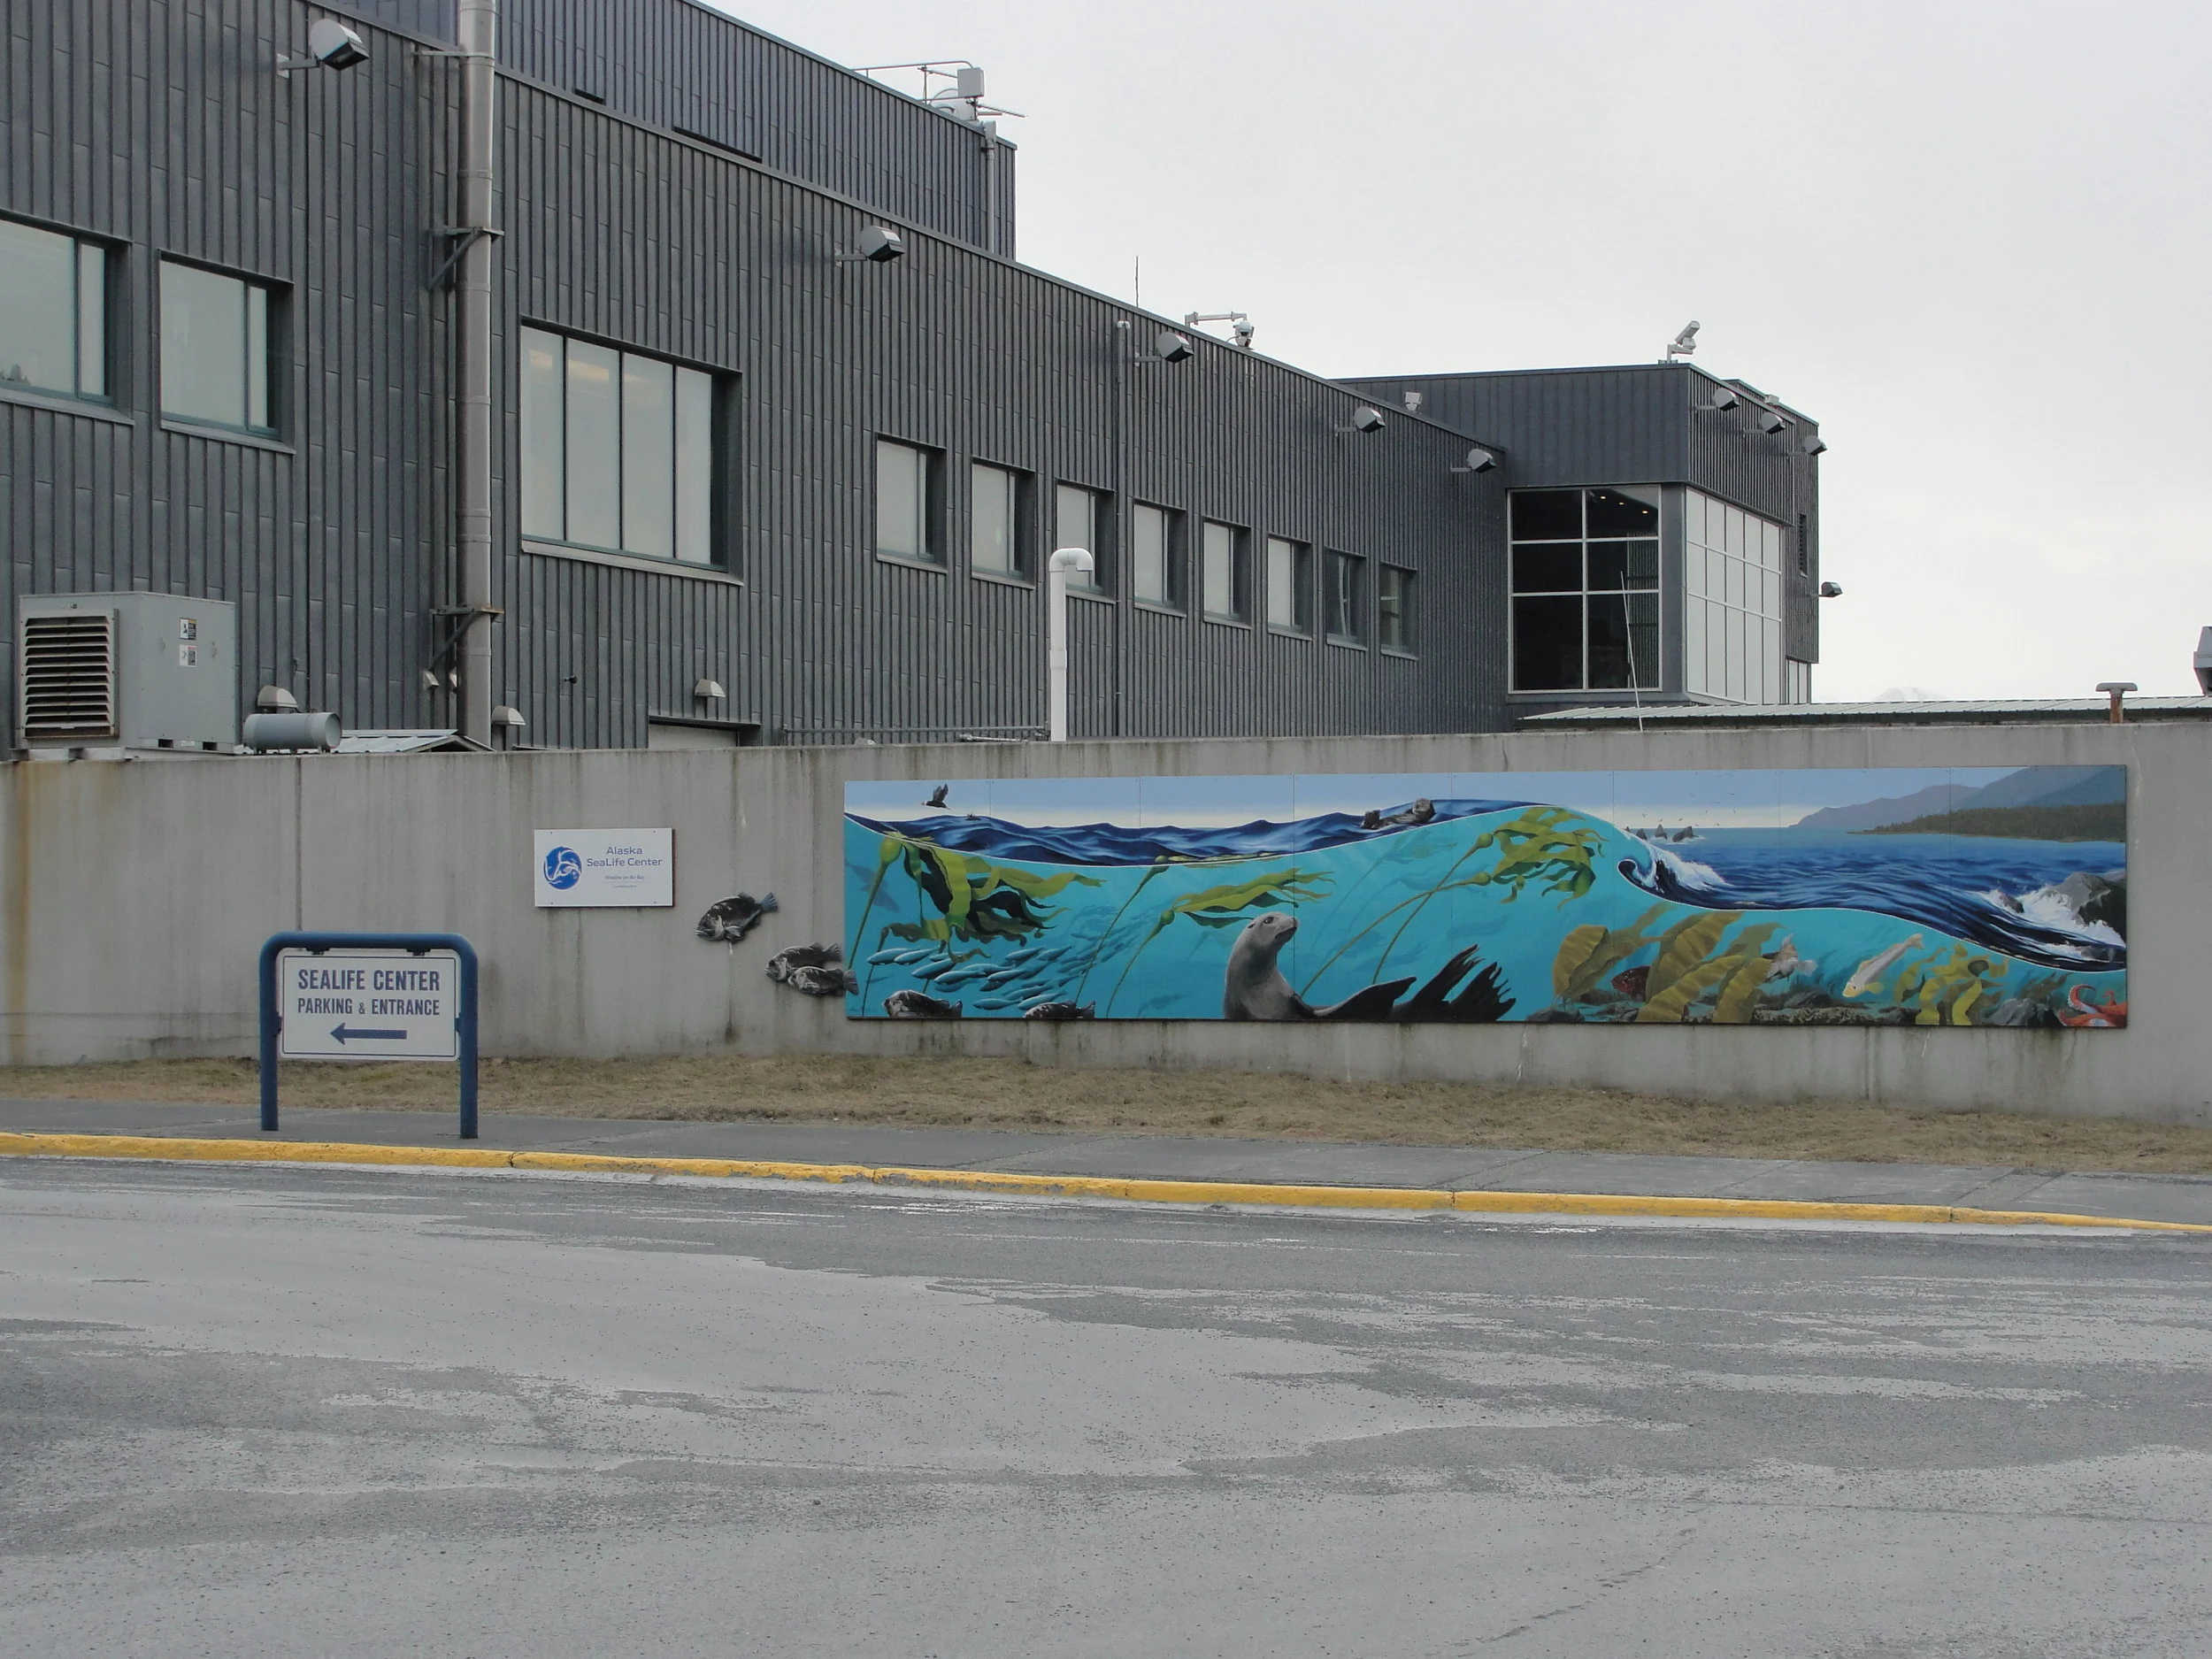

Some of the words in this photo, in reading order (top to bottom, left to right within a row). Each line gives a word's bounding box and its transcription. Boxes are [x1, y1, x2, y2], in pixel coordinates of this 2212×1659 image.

[587, 858, 626, 867] SeaLife
[627, 857, 664, 866] Center
[297, 969, 365, 990] SEALIFE
[373, 970, 440, 991] CENTER
[297, 997, 353, 1014] PARKING
[358, 1002, 365, 1015] &
[372, 999, 440, 1016] ENTRANCE
